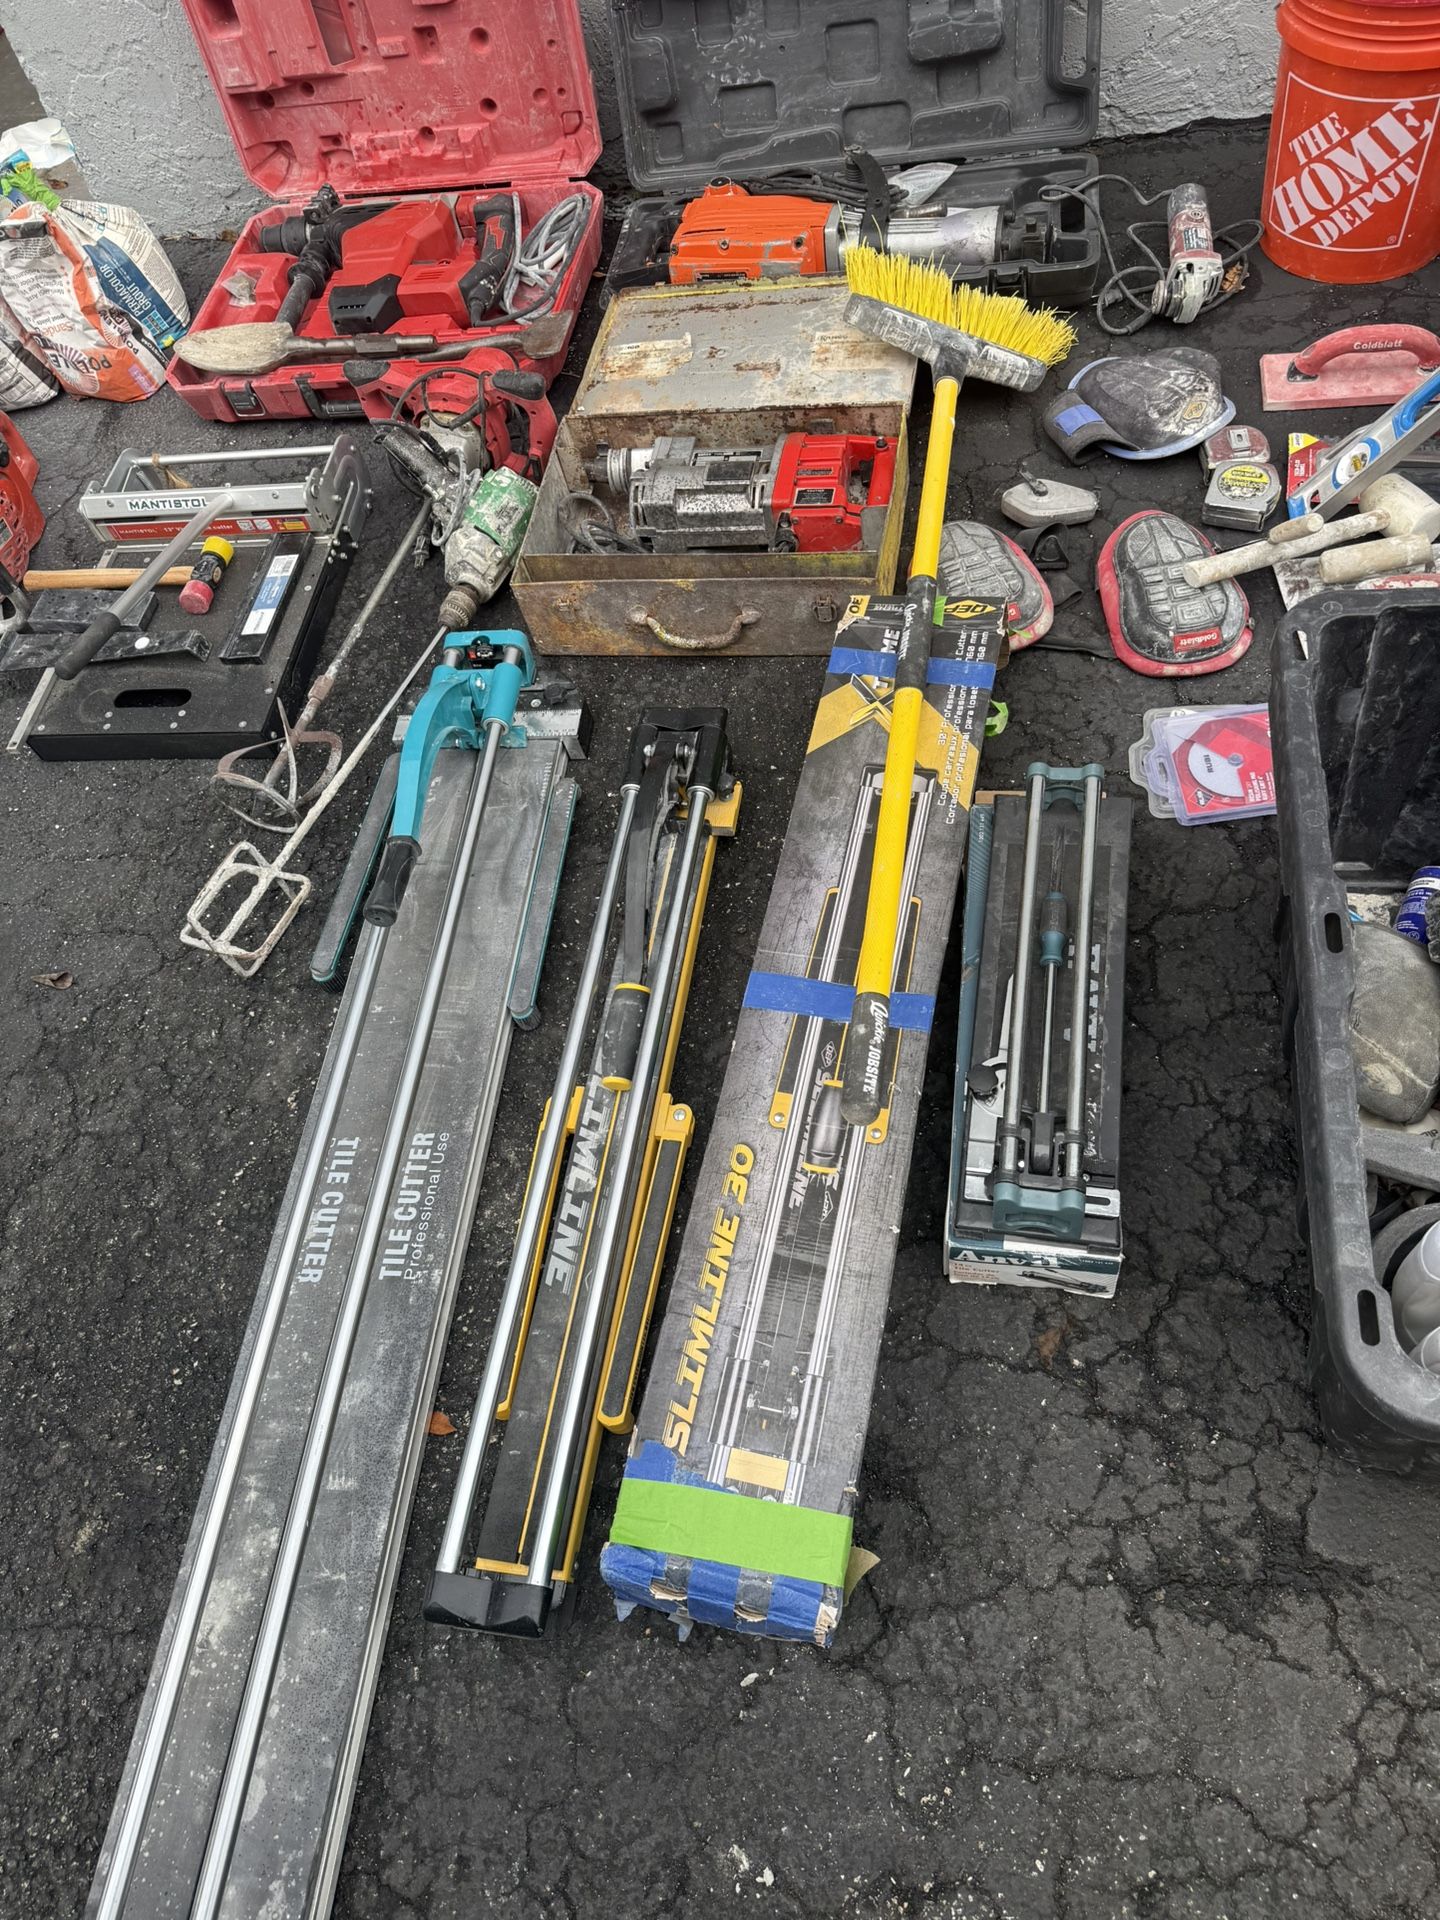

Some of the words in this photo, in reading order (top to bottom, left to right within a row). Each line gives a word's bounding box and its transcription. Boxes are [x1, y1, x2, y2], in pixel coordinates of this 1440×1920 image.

[1288, 112, 1350, 165] THE
[1273, 100, 1433, 234] HOME
[1311, 157, 1418, 246] DEPOT
[99, 263, 144, 317] PERMACOLOR
[126, 282, 153, 312] GROUT
[41, 322, 74, 338] Sande
[1353, 339, 1403, 350] Goldblatt
[128, 498, 209, 511] MANTISTOL
[944, 604, 988, 613] QEP
[970, 630, 979, 644] mm
[981, 631, 989, 645] mm
[1178, 631, 1218, 647] Goldblatt
[940, 684, 956, 727] Profession
[955, 629, 968, 656] Cutter
[968, 685, 980, 708] loset
[953, 685, 967, 733] professionn
[964, 710, 977, 730] para
[943, 735, 959, 776] carreaux
[954, 732, 971, 782] profesional
[1202, 754, 1214, 773] RUBI
[937, 778, 950, 806] Coupe
[945, 784, 960, 824] Cortador
[871, 999, 888, 1042] Quickie
[863, 1048, 882, 1095] JOBSITE
[327, 1136, 360, 1184] TILE
[394, 1132, 436, 1221] CUTTER
[403, 1169, 441, 1280] Professional
[431, 1132, 450, 1165] Use
[298, 1191, 344, 1283] CUTTER
[379, 1229, 412, 1280] TILE
[662, 1207, 740, 1456] SLIMLINE
[722, 1143, 754, 1205] 30
